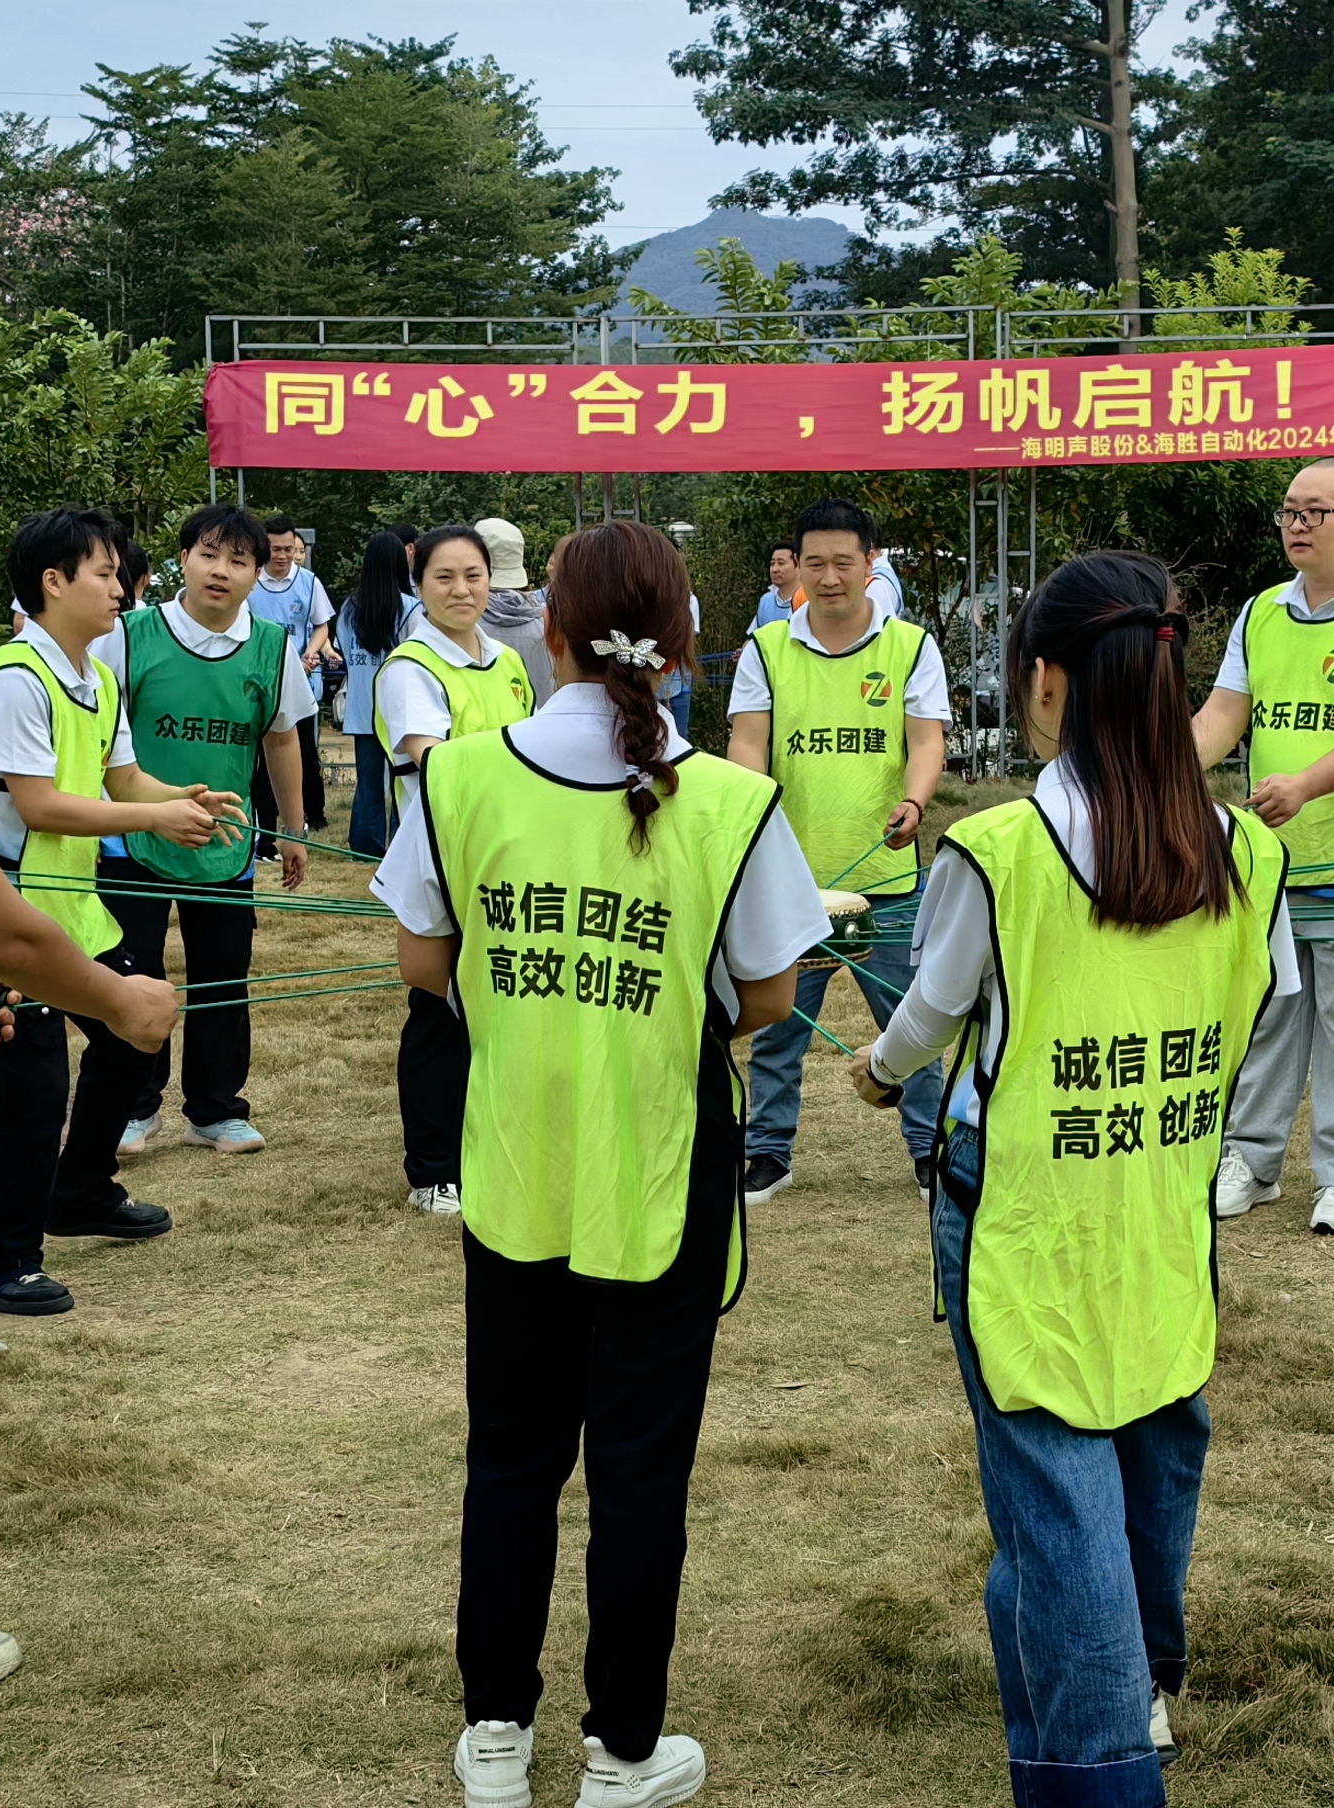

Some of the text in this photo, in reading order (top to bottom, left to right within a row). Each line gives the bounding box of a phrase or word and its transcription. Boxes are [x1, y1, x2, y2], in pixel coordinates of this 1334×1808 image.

[154, 713, 253, 746] 众乐团建
[787, 727, 887, 756] 众乐团建
